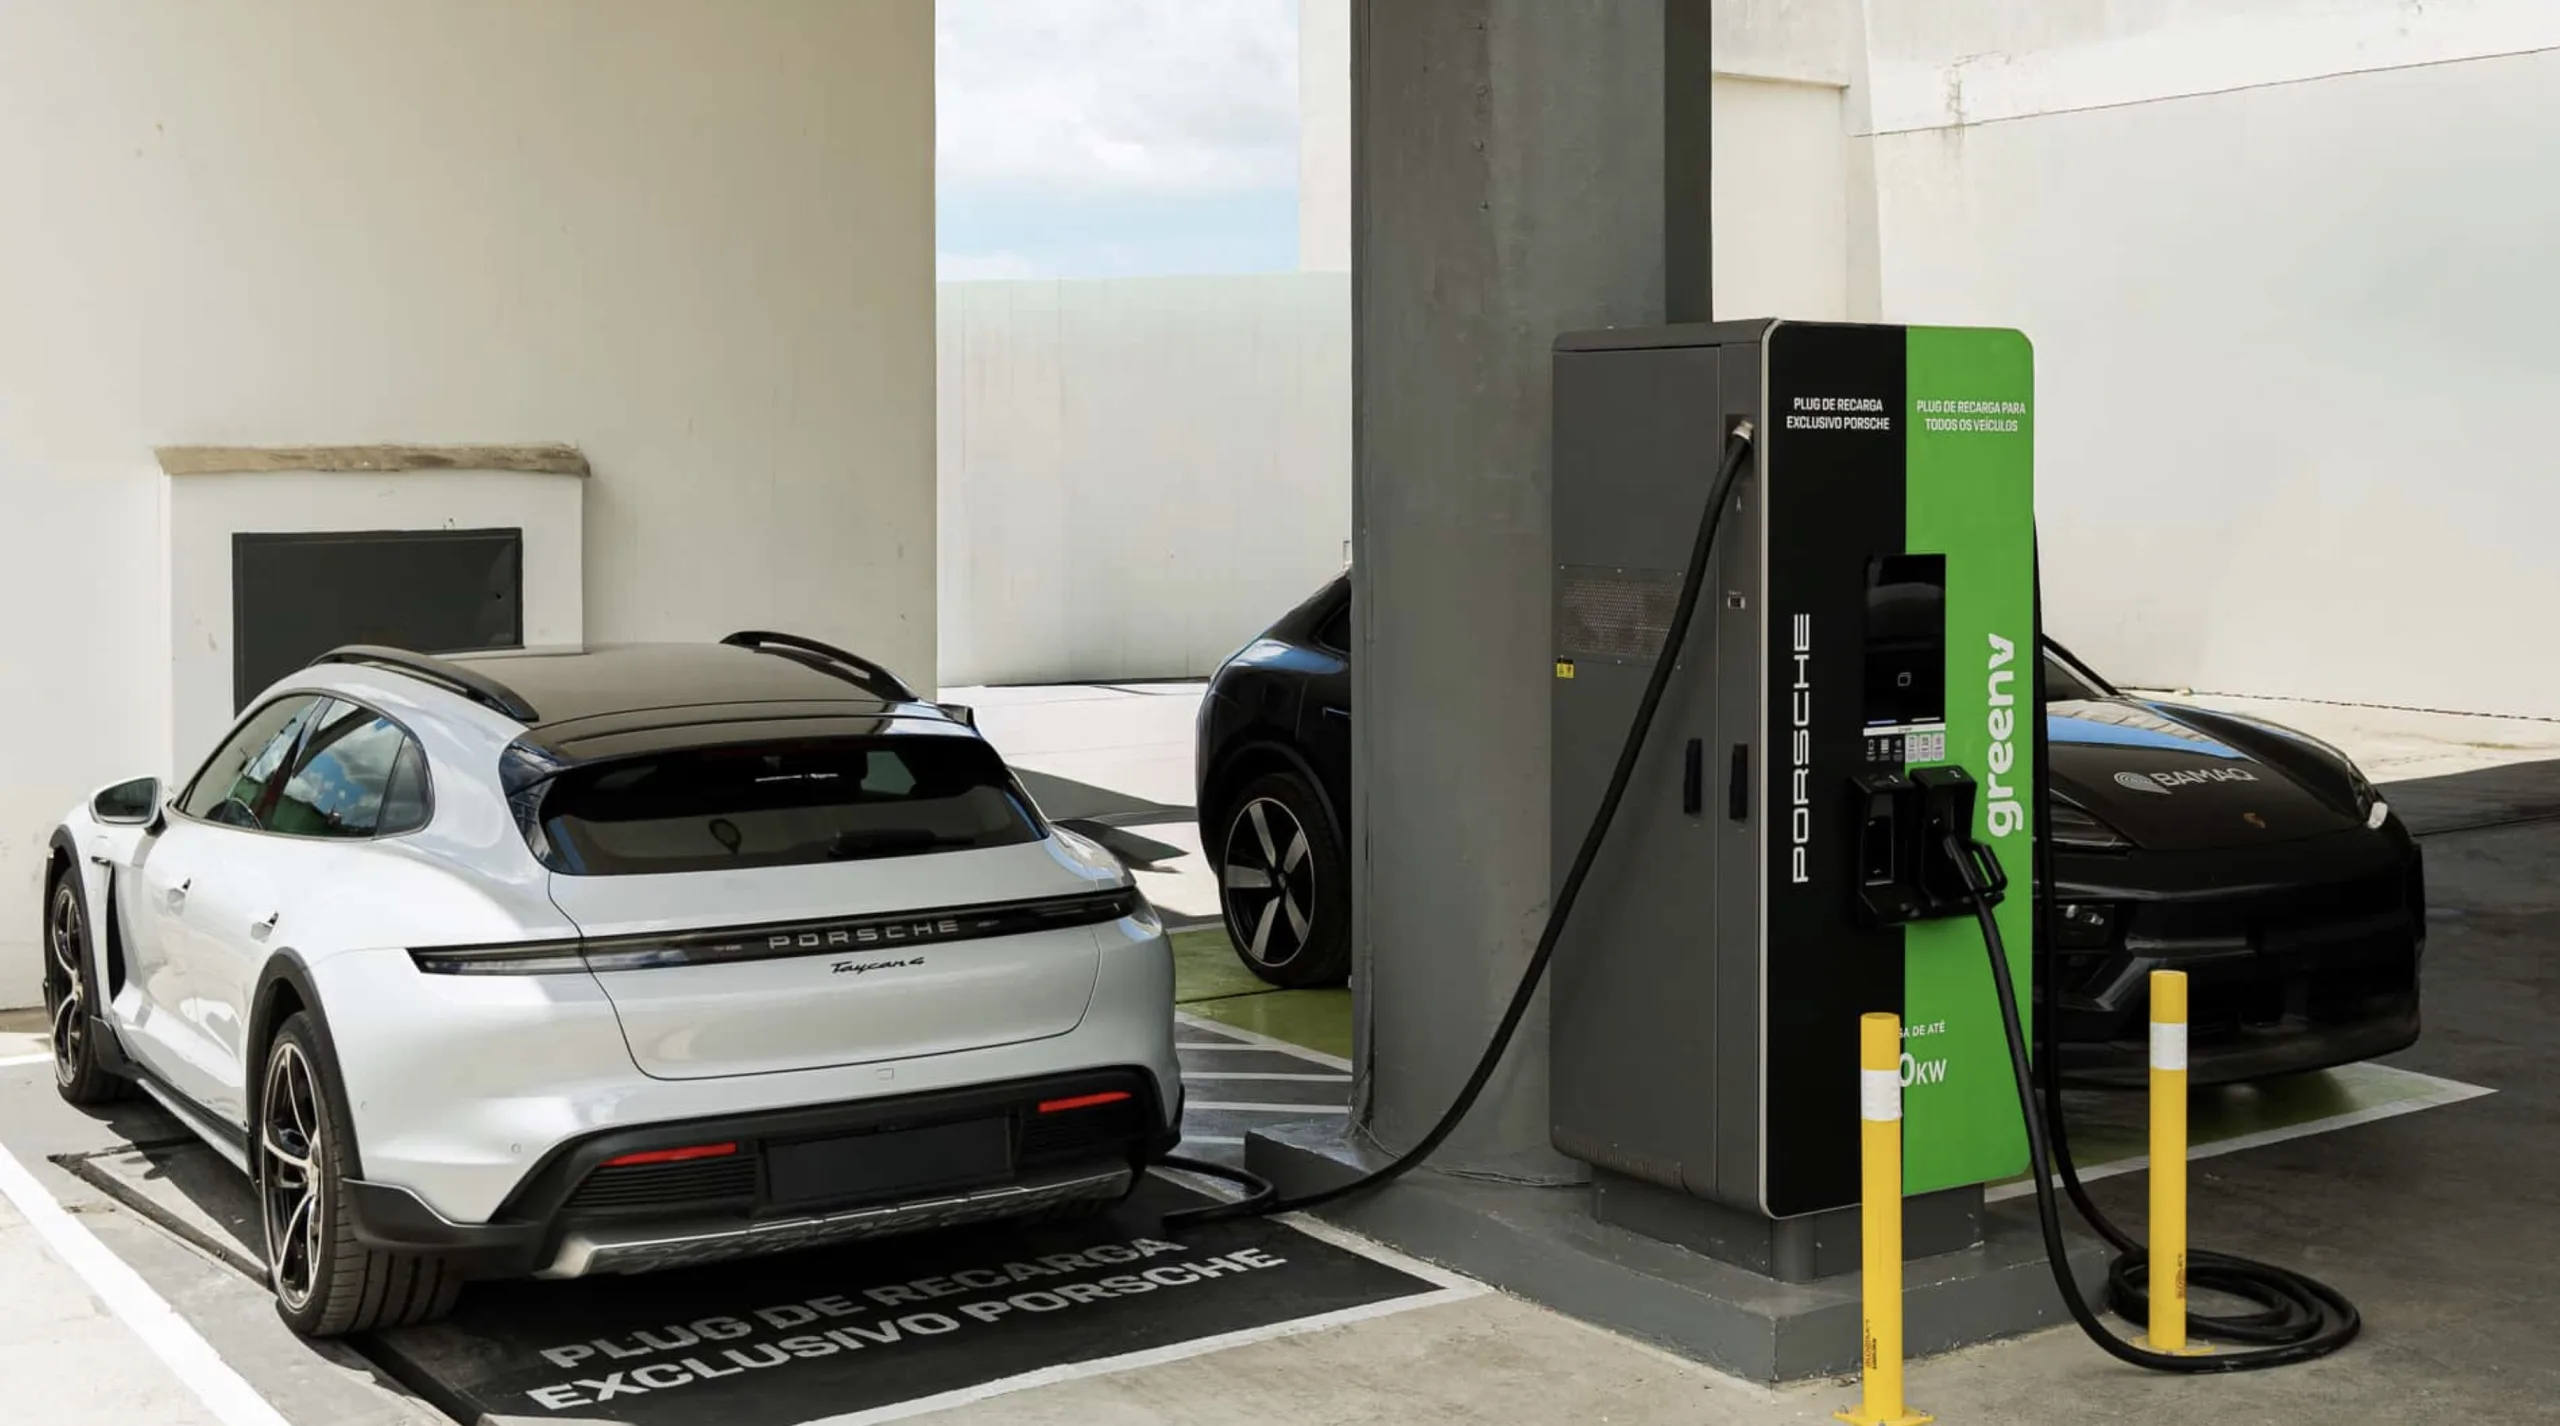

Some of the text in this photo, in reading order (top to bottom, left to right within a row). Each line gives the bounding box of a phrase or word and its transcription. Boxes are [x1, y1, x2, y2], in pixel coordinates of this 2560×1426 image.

[1793, 397, 1883, 412] PLUG DE RECARGA
[1917, 399, 2026, 414] PLUG DE RECARGA PARA
[1786, 416, 1890, 430] EXCLUSIVO PORSCHE
[1924, 417, 2018, 432] TODOS OS VEÍCULOS
[1987, 633, 2024, 837] greenv
[1792, 613, 1810, 883] PORSCHE
[2150, 767, 2260, 787] BAMAQ
[768, 919, 959, 950] PORSCHE
[830, 958, 906, 974] Taycan
[1912, 1024, 1926, 1037] DE
[1927, 1019, 1946, 1035] ATÉ
[1900, 1052, 1947, 1087] 0KW
[539, 1237, 1190, 1369] PLUG DE RECARGA
[525, 1247, 1288, 1411] EXCLUSIVO PORSCHE
